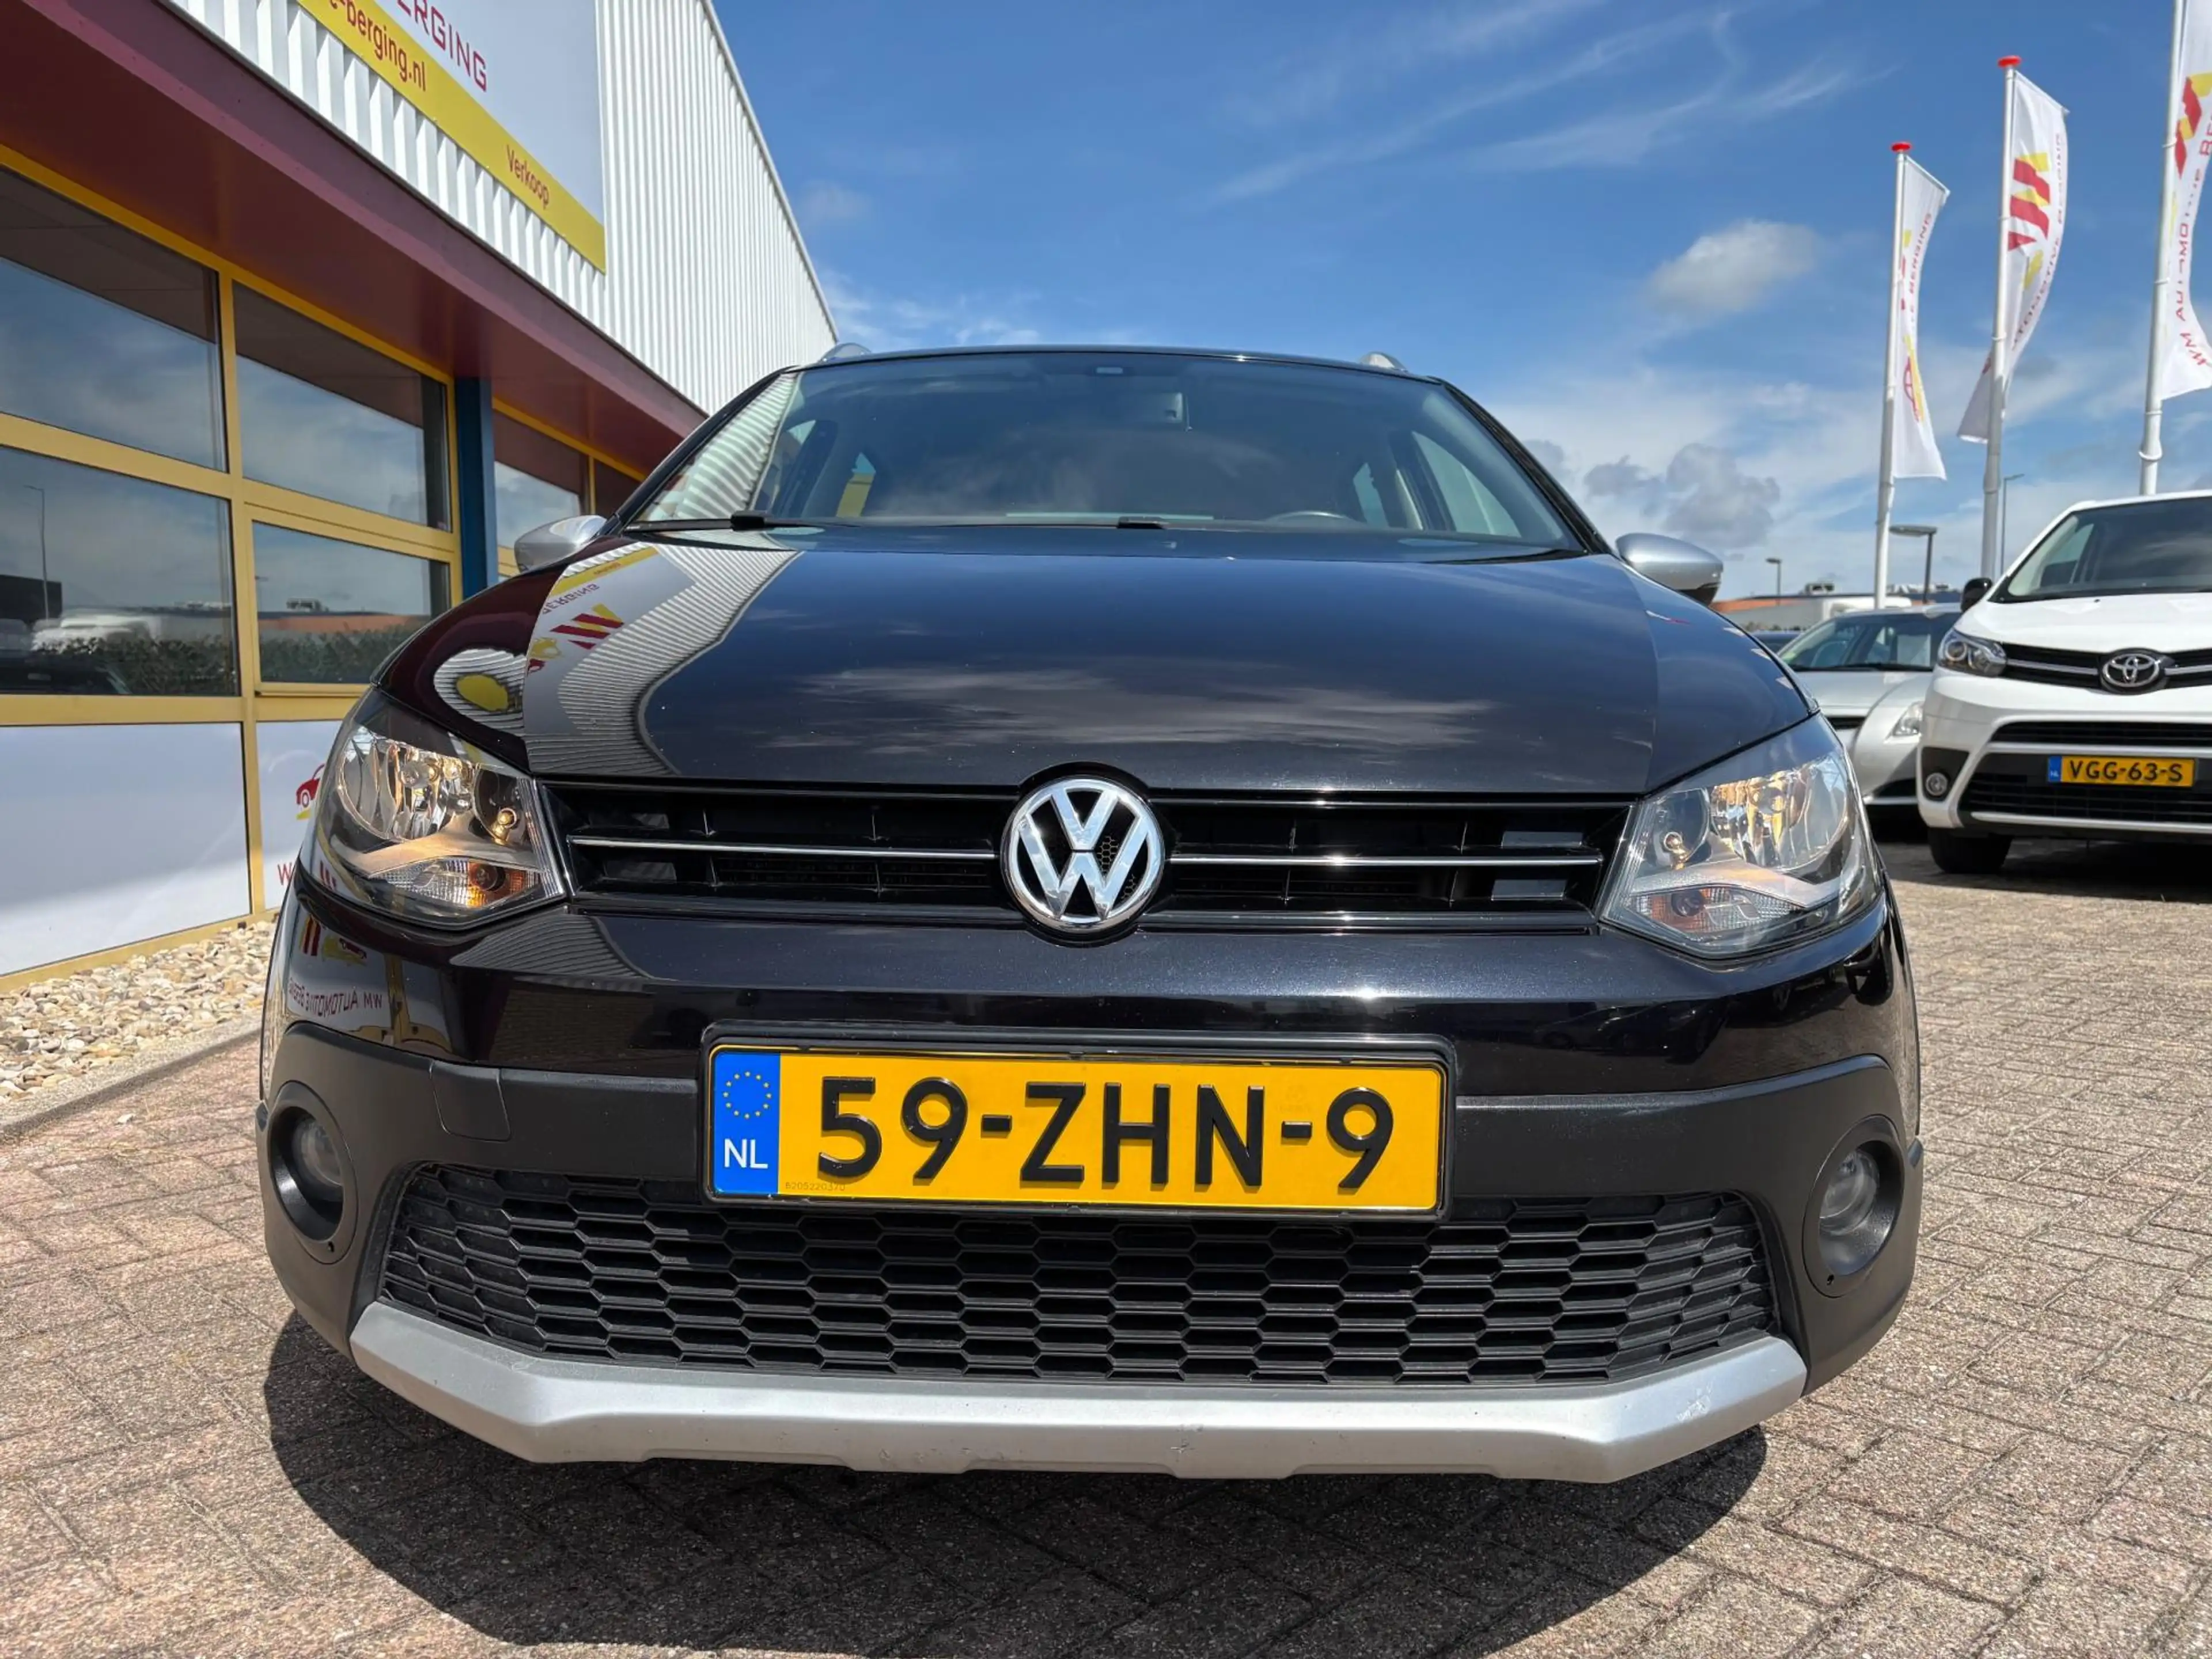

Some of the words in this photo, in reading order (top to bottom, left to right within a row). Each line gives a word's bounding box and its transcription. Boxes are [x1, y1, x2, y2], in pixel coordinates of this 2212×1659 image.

[507, 144, 550, 210] Verkoop
[2180, 332, 2207, 366] WM
[2069, 760, 2183, 782] VGG-63-S
[818, 1075, 1393, 1194] 59-ZHN-9
[724, 1138, 768, 1169] NL
